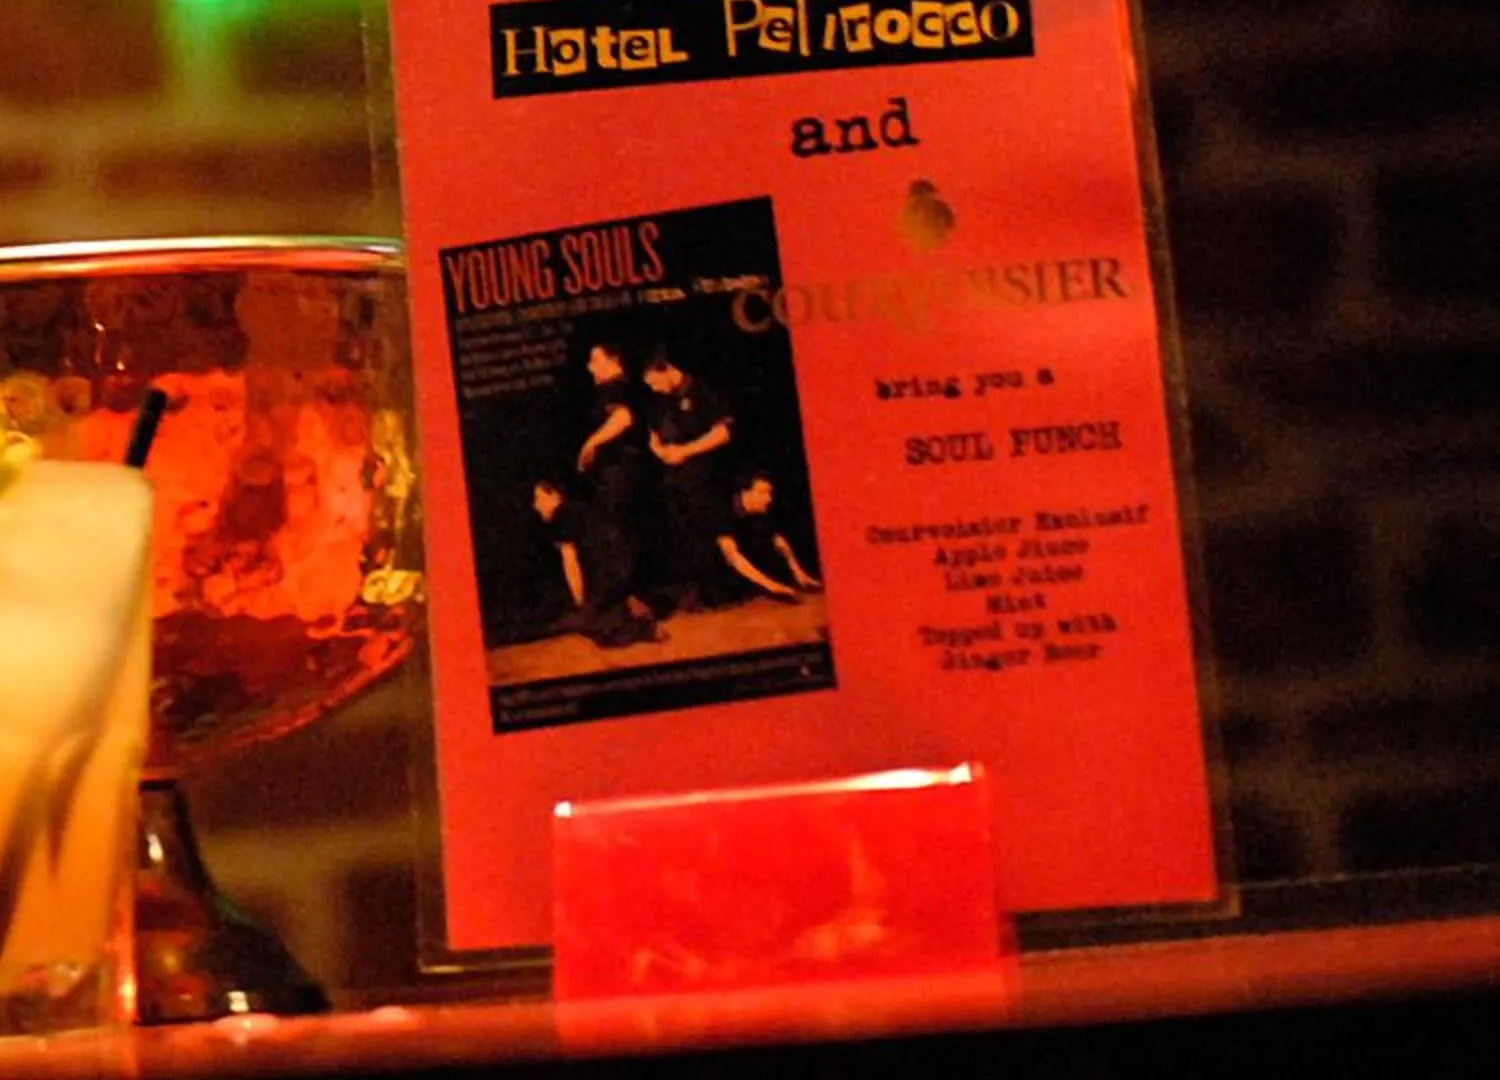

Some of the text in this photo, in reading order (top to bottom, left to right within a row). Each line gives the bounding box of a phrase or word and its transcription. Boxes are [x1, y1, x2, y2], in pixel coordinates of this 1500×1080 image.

[791, 98, 919, 157] and
[446, 238, 556, 313] YOUNG
[560, 220, 665, 296] SOULS
[974, 370, 1023, 396] you
[905, 431, 994, 465] SOUL
